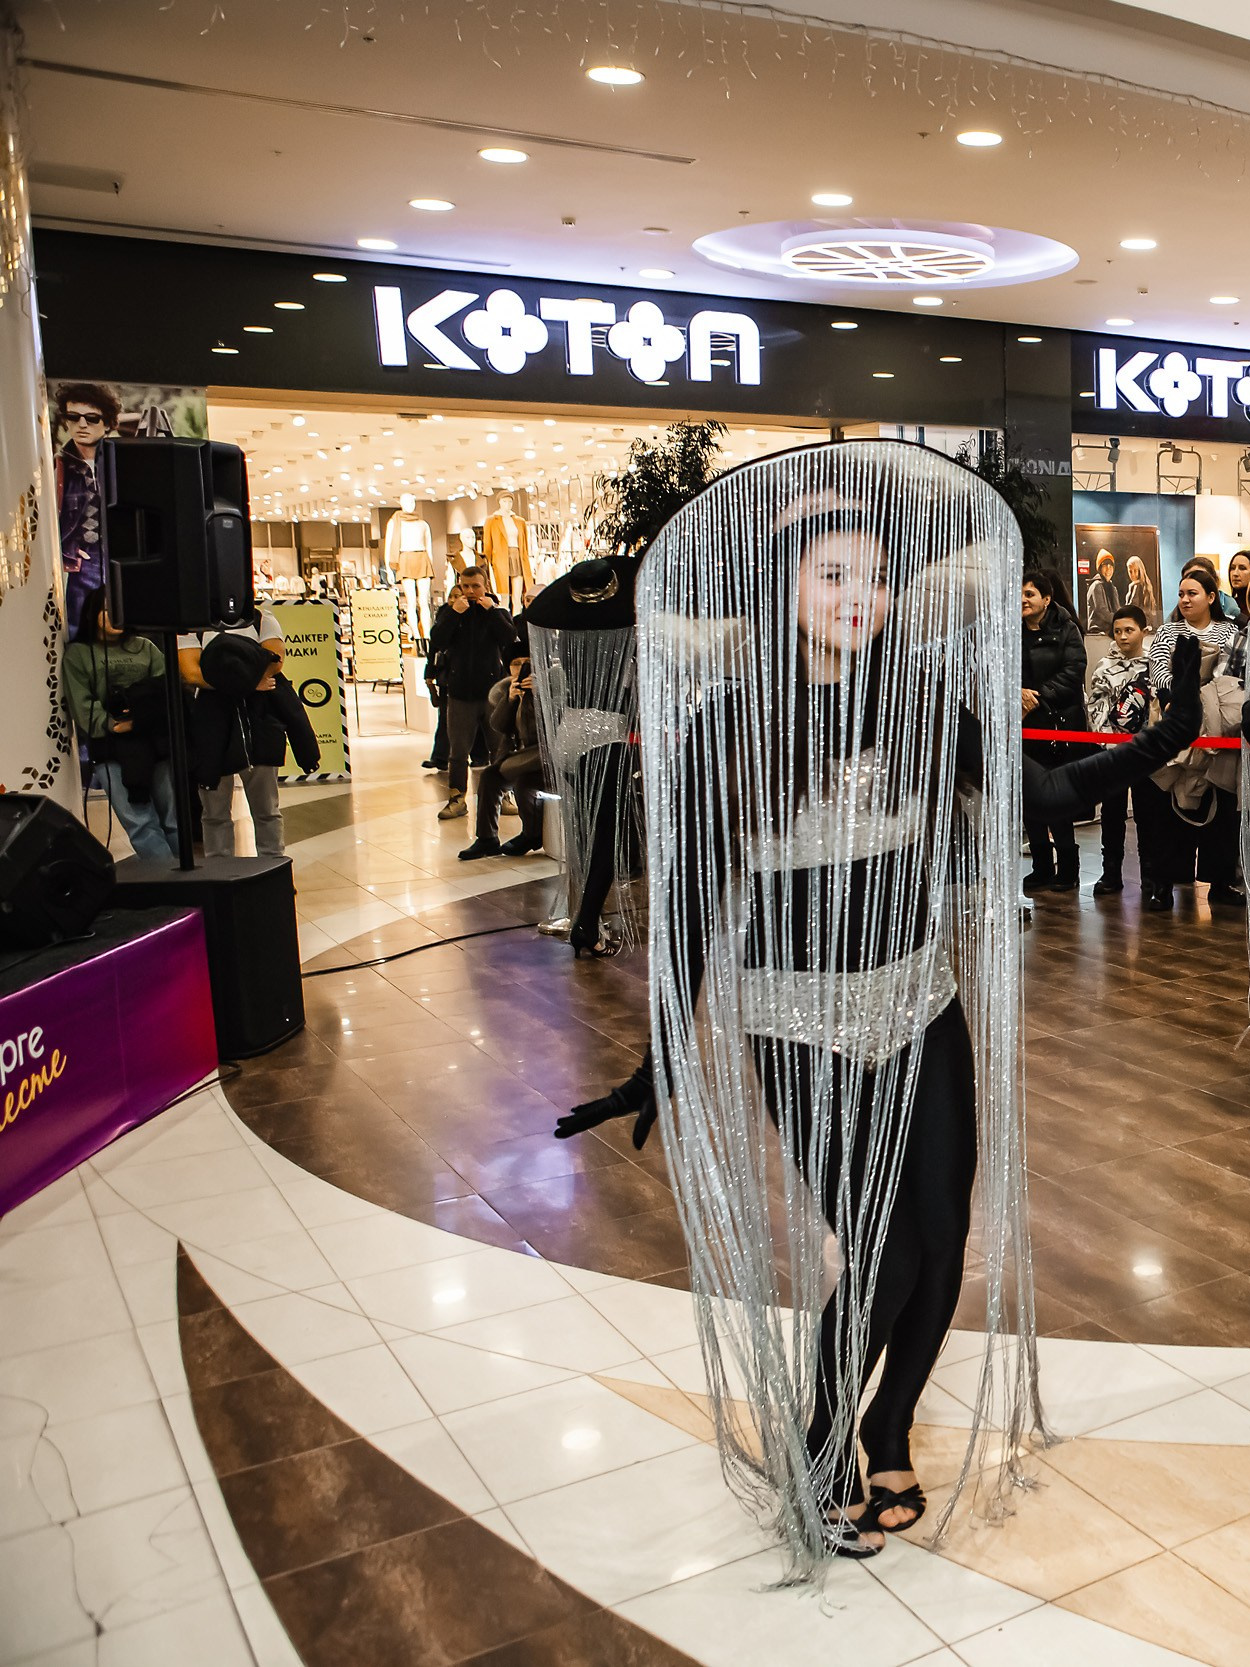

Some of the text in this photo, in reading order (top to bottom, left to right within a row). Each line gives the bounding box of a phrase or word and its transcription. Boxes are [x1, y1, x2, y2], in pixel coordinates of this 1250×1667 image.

[374, 285, 762, 386] KOTON
[284, 633, 329, 644] ЛДІКТЕР
[285, 646, 318, 658] ИДКИ
[0, 1026, 45, 1087] рге
[0, 1048, 68, 1133] есте
